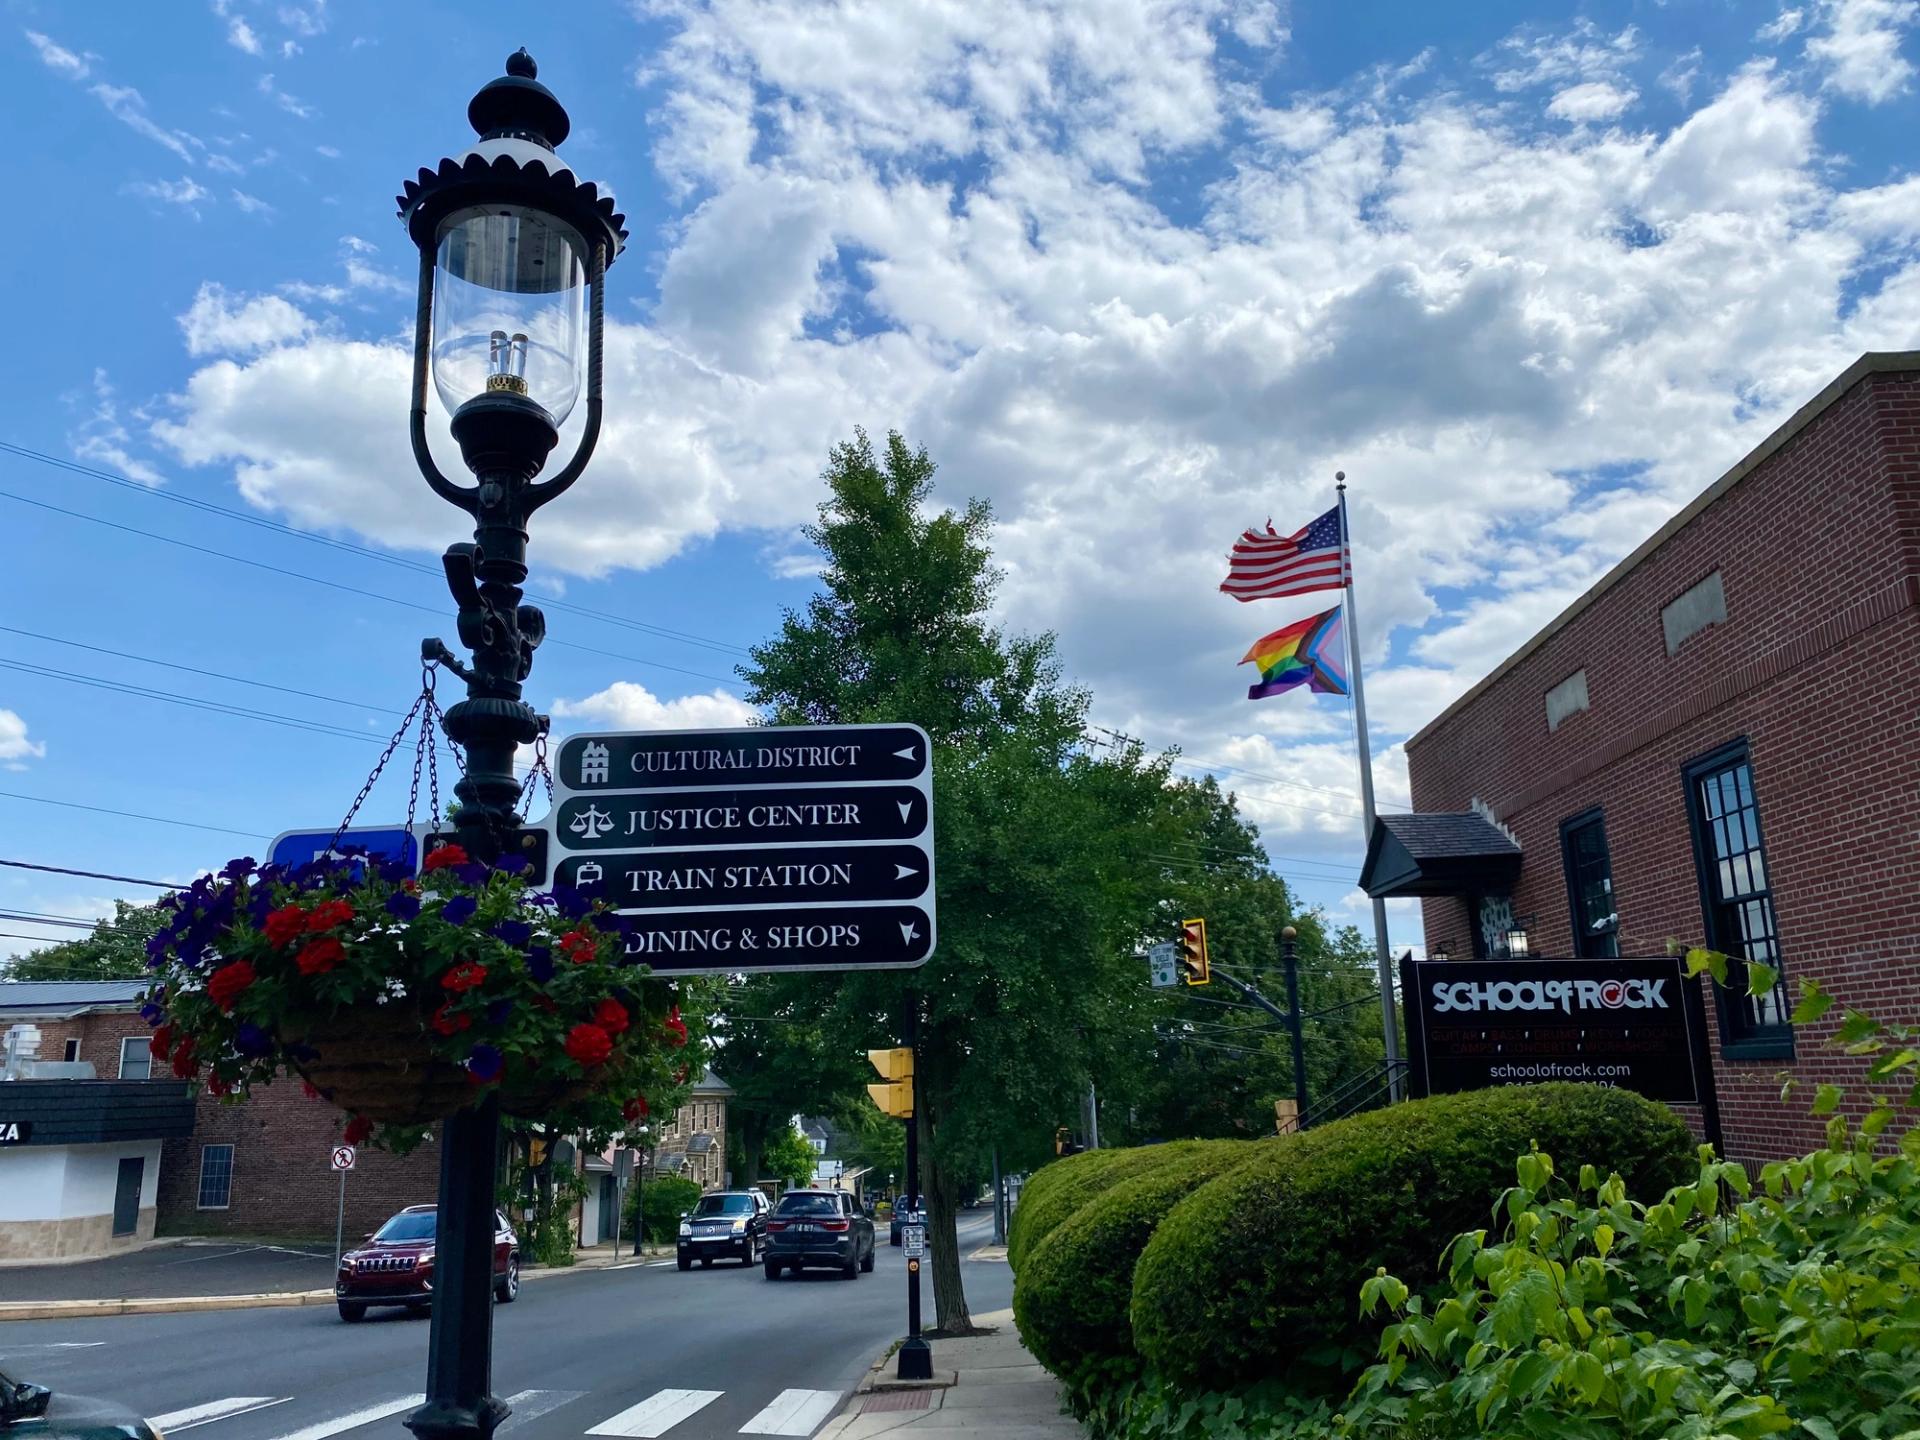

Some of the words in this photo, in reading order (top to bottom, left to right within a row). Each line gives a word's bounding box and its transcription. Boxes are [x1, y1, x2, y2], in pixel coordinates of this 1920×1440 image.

[630, 749, 752, 773] CULTURAL
[757, 745, 861, 769] DISTRICT
[624, 806, 741, 836] JUSTICE
[748, 803, 861, 828] CENTER
[625, 867, 716, 892] TRAIN
[724, 863, 852, 889] STATION
[624, 928, 733, 954] DINING
[739, 927, 760, 951] &
[767, 924, 860, 949] SHOPS
[1490, 1062, 1631, 1077] schoolofrock.com
